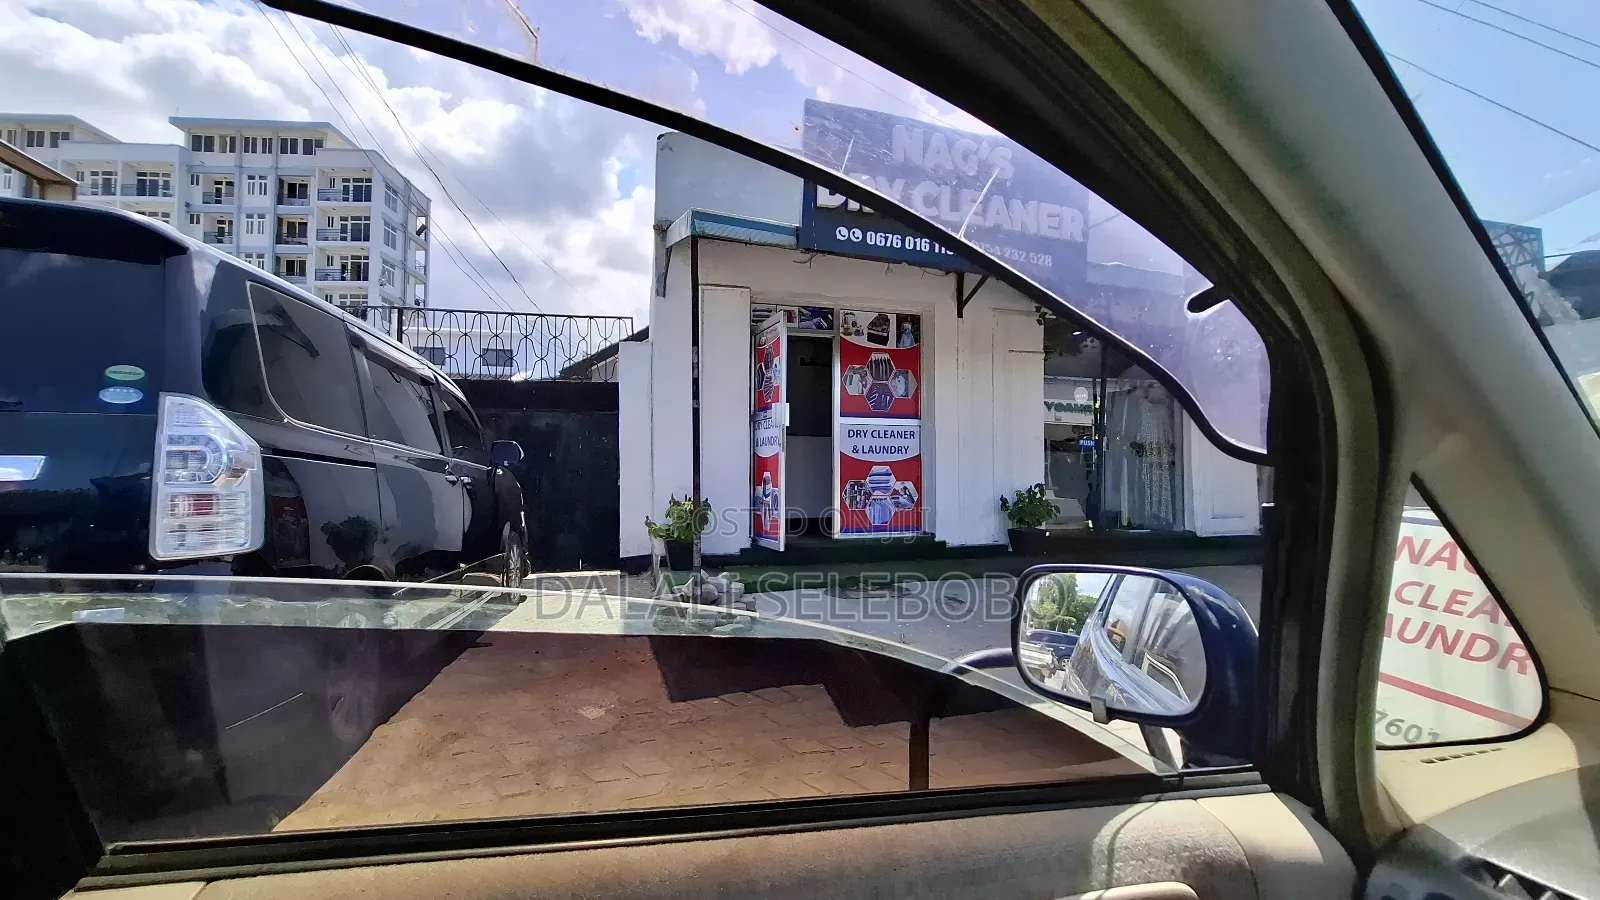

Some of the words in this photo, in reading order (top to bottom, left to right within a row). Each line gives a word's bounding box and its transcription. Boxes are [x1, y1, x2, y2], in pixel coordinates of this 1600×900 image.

[891, 124, 1016, 180] NAG'S
[910, 180, 1084, 242] CLEANER
[866, 231, 902, 249] 0676
[904, 238, 930, 252] 016
[933, 241, 955, 255] 11
[1003, 248, 1027, 262] 232
[1029, 253, 1053, 267] 528
[847, 429, 867, 439] DRY
[870, 429, 916, 440] CLEANER
[852, 445, 860, 454] &
[862, 445, 910, 455] LAUNDRY
[1394, 580, 1515, 628] CLEA
